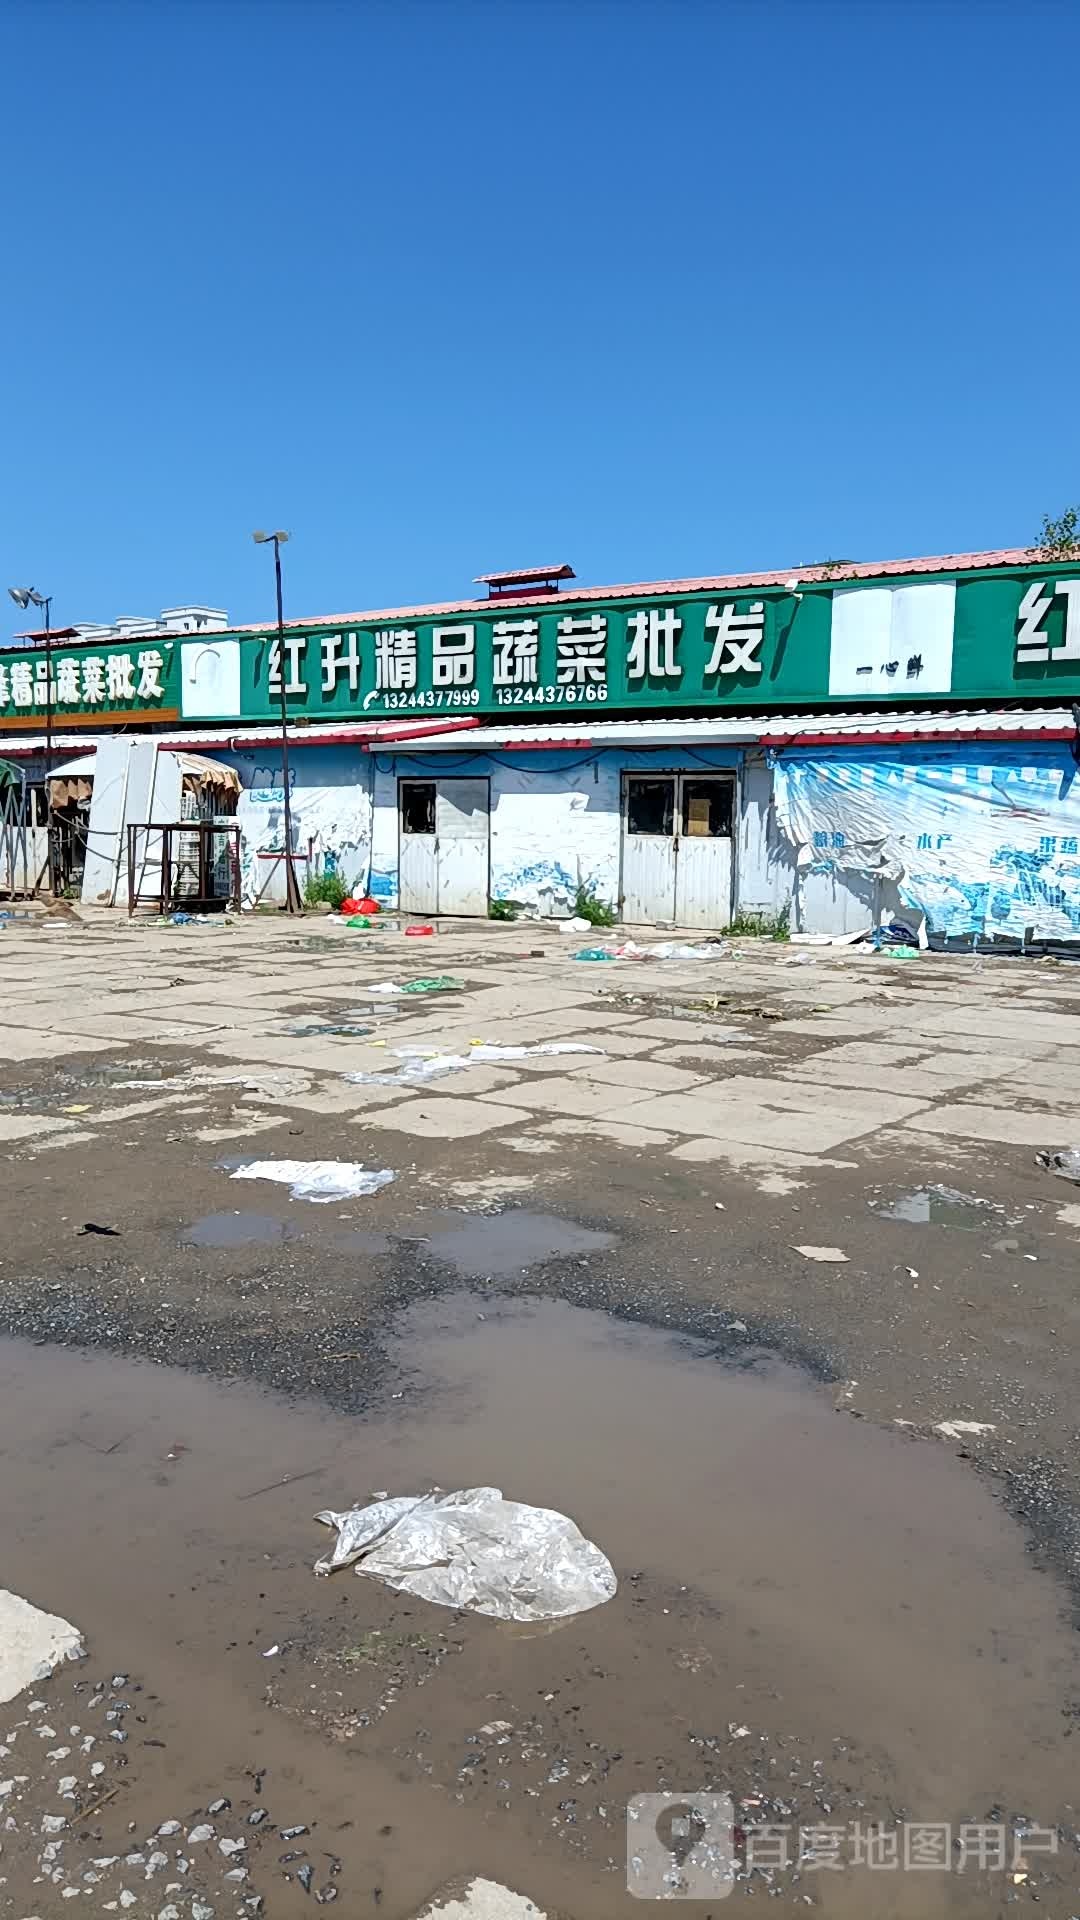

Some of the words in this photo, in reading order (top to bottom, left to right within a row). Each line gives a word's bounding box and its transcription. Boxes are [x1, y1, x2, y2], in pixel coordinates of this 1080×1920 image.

[269, 602, 764, 694] 红升精品蔬菜批发
[383, 689, 479, 709] 13244377999
[496, 684, 608, 704] 13244376766
[917, 833, 952, 849] 水产
